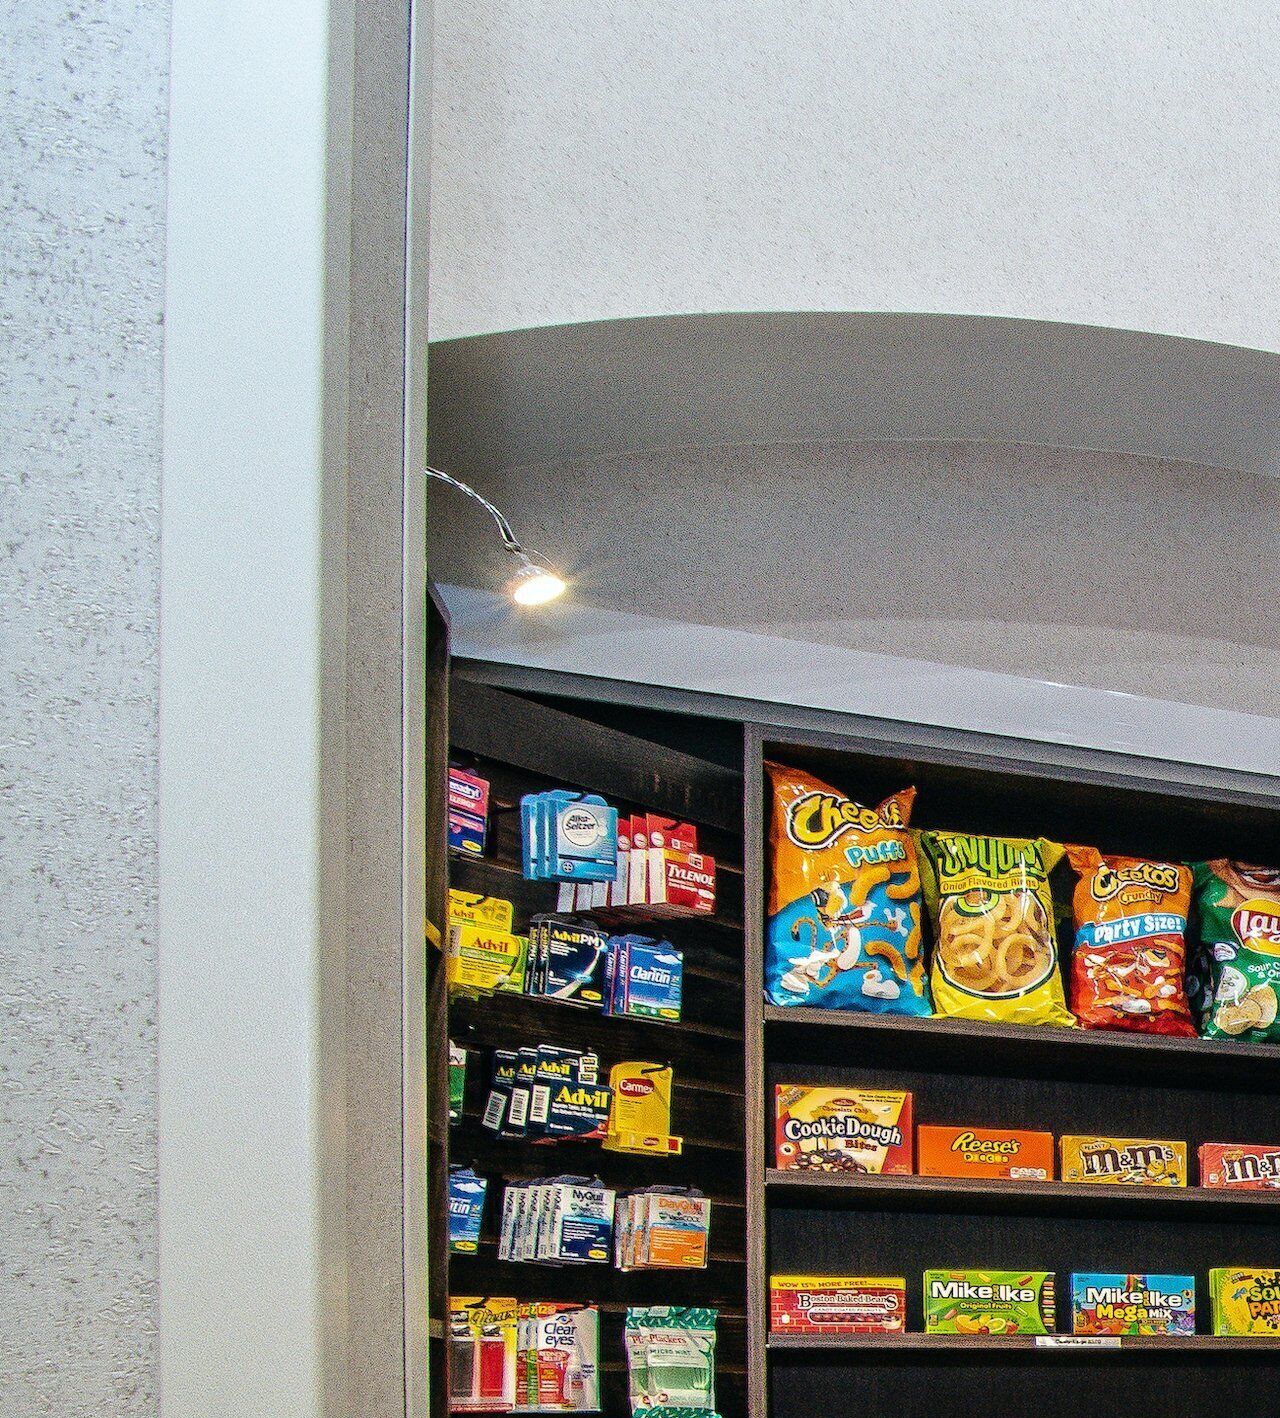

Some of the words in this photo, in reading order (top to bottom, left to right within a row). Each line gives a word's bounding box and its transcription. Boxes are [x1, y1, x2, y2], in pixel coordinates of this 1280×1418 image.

[565, 822, 596, 831] Seltzer
[789, 792, 904, 849] Chee
[667, 863, 714, 886] TYLENOL
[968, 878, 1007, 888] Flavored
[1094, 920, 1141, 943] Party
[1144, 915, 1181, 931] Size!
[473, 936, 509, 953] Advil
[630, 965, 670, 984] Claritin
[1248, 962, 1271, 973] Sour
[538, 1061, 570, 1075] Advil
[620, 1079, 654, 1093] Carmex
[555, 1086, 609, 1108] Advil
[845, 1140, 877, 1151] Bites
[952, 1132, 1020, 1153] Reese's
[1082, 1145, 1174, 1176] m&m's
[931, 1281, 993, 1299] Mike
[1000, 1285, 1036, 1302] Ike
[1087, 1287, 1143, 1303] Mike
[1151, 1290, 1182, 1307] Ike
[798, 1294, 835, 1308] Boston
[960, 1301, 991, 1310] Original
[1096, 1303, 1148, 1321] Mega
[544, 1323, 576, 1335] Clear
[545, 1335, 575, 1347] eyes
[650, 1333, 687, 1345] Plackers
